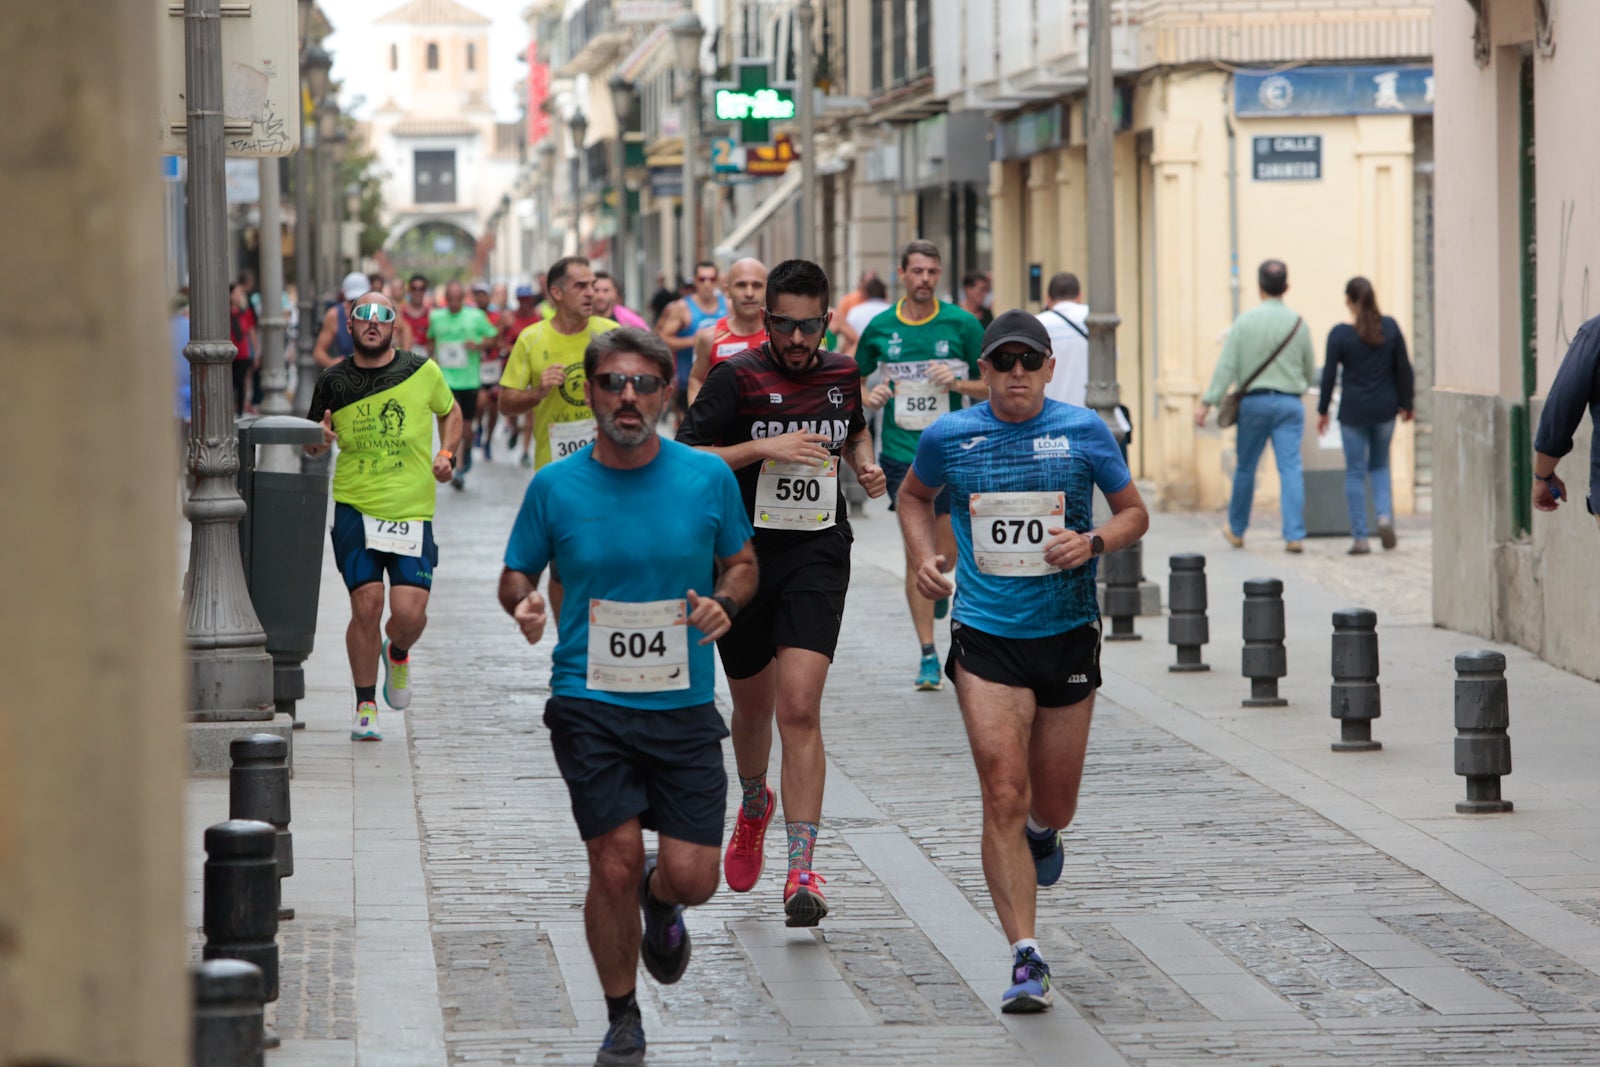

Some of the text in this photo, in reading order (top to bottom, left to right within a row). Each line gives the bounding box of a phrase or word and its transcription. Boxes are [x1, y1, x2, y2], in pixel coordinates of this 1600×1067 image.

[1273, 136, 1318, 152] CALLE
[356, 404, 371, 418] XI
[906, 396, 937, 411] 582
[352, 424, 377, 435] Fondo
[751, 419, 850, 441] GRANAD
[356, 439, 407, 452] ROMANA
[1038, 441, 1065, 449] LOJA
[775, 478, 820, 502] 590
[375, 518, 410, 536] 729
[991, 519, 1044, 545] 670
[609, 630, 667, 658] 604
